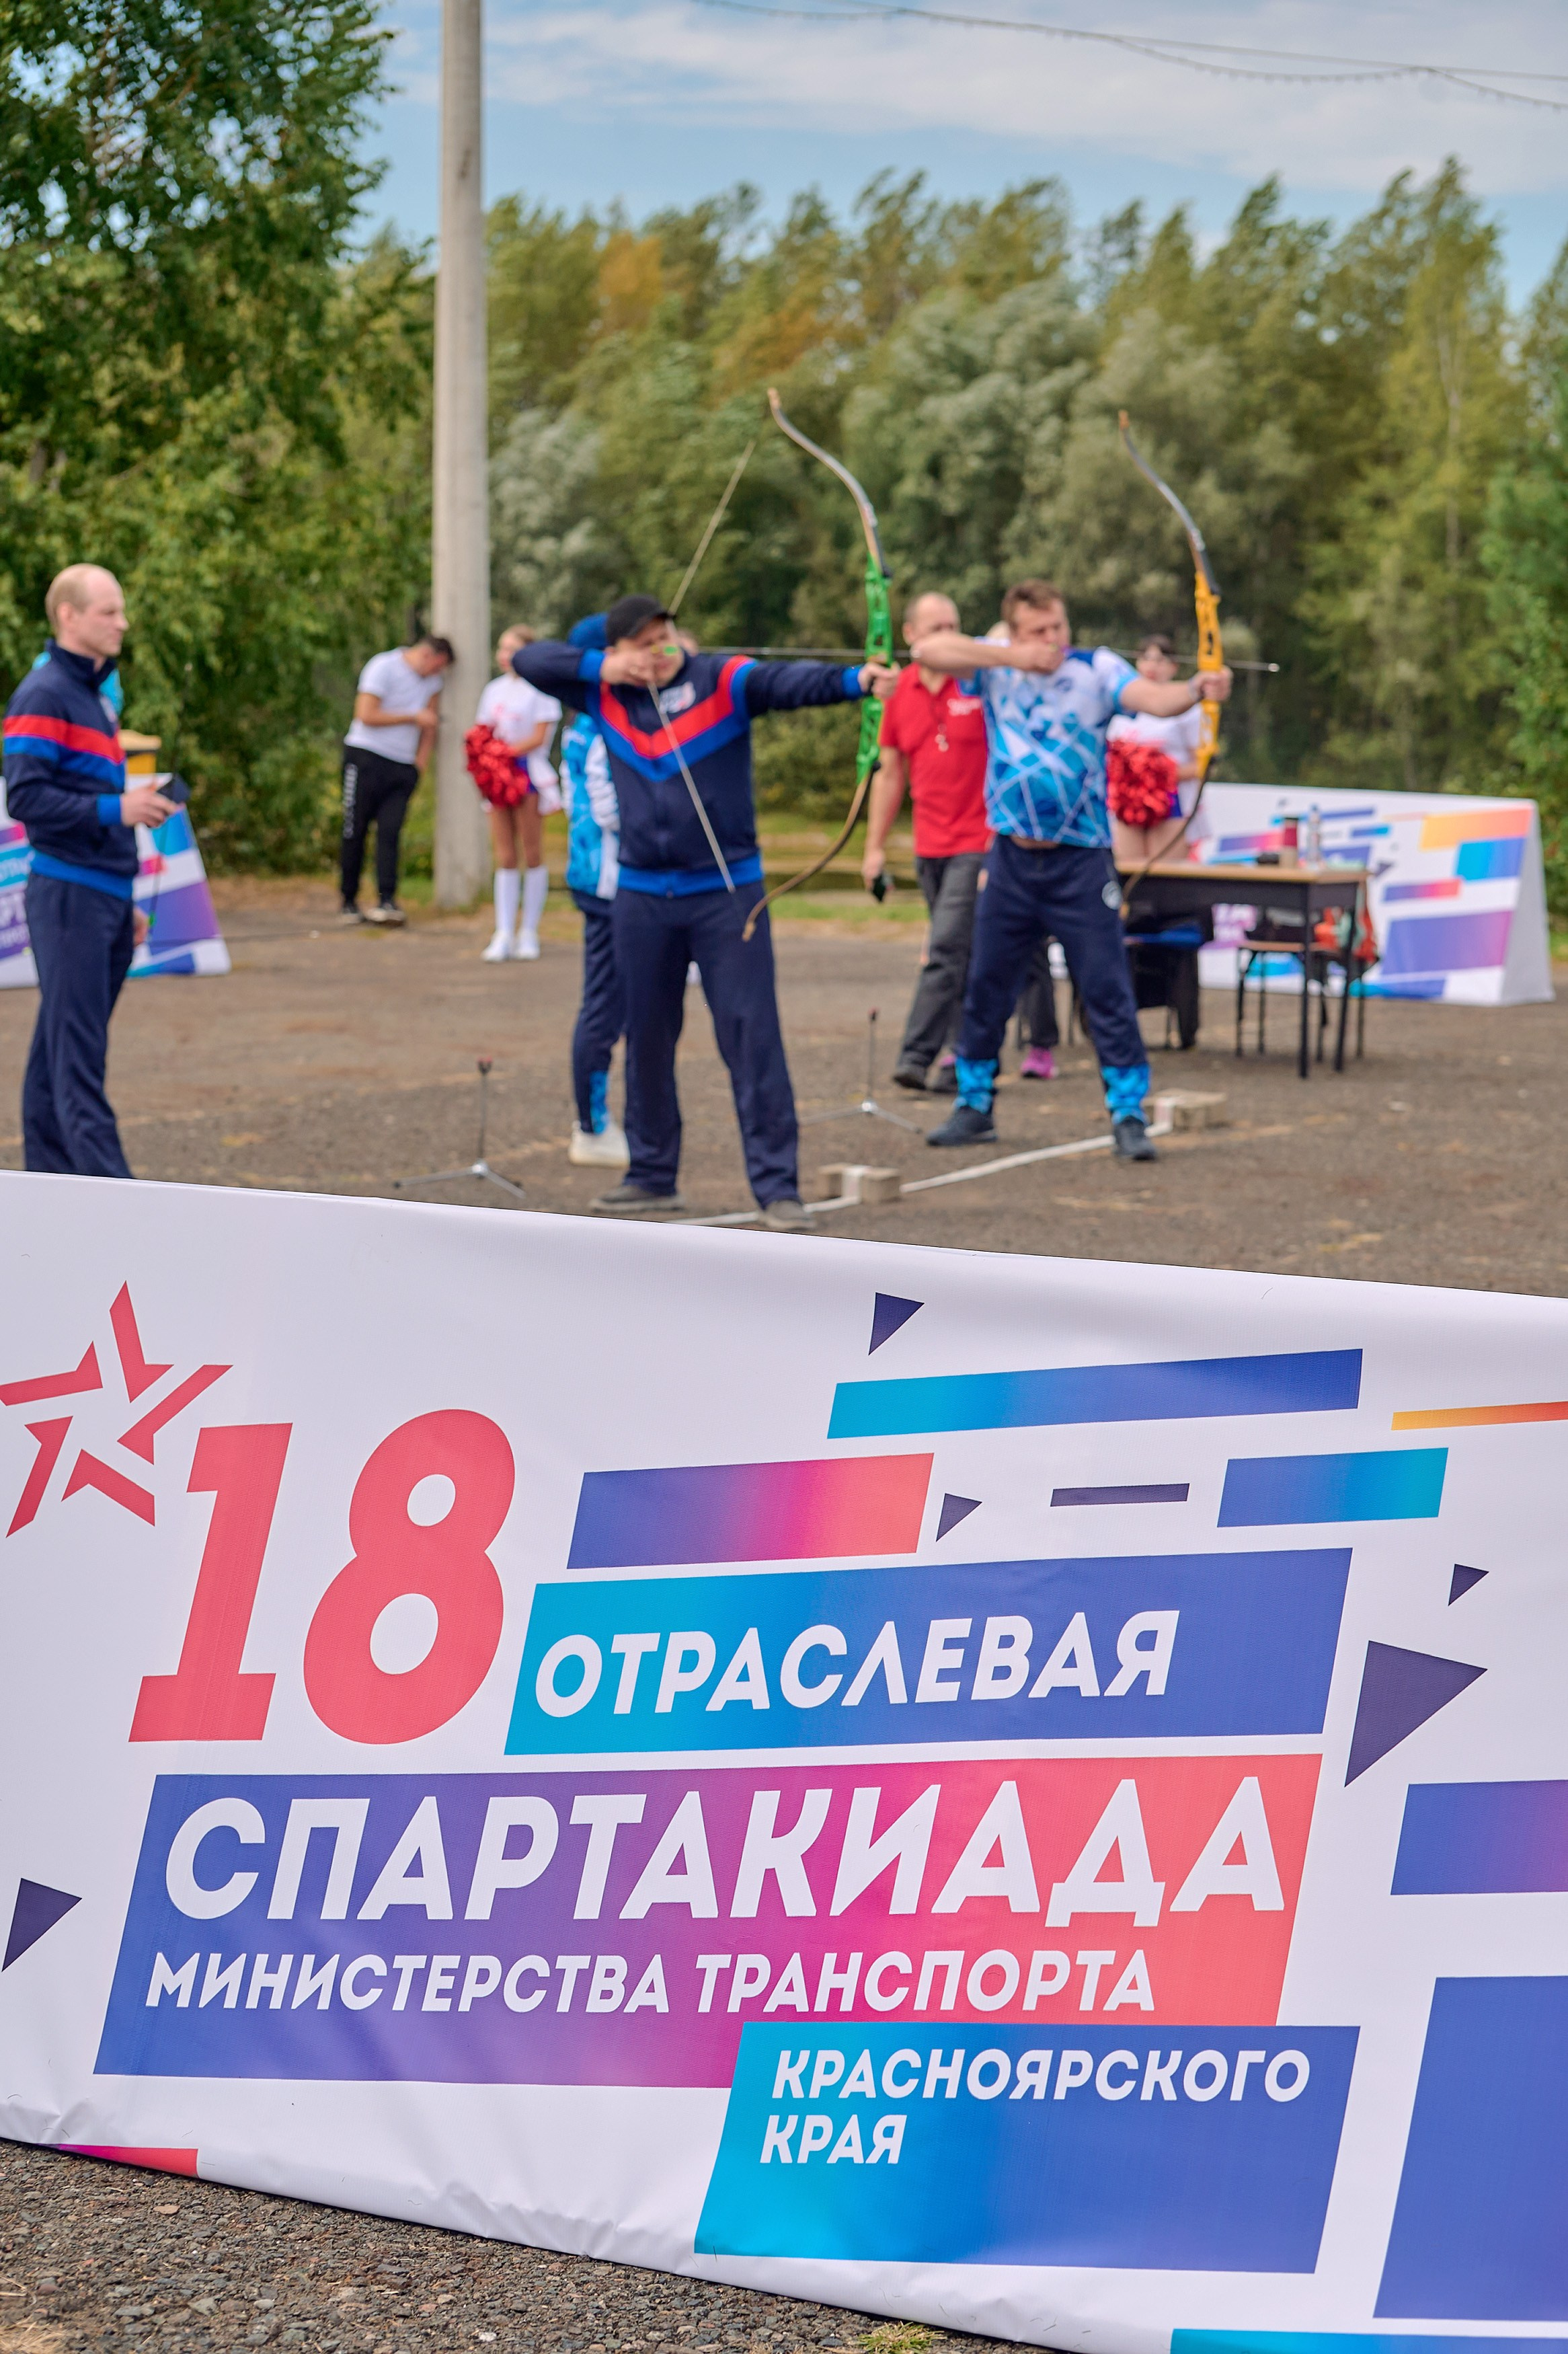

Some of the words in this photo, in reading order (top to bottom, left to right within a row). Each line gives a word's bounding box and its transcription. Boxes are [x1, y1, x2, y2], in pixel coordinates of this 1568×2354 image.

[128, 1409, 515, 1744] 18
[535, 1610, 1180, 1718] ОТРАСЛЕВАЯ
[165, 1776, 1286, 1928] СПАРТАКИАДА
[145, 1952, 670, 2013] МИНИСТЕРСТВА
[695, 1949, 1154, 2013] ТРАНСПОРТА
[771, 2048, 1310, 2102] КРАСНОЯРСКОГО
[760, 2114, 908, 2164] КРАЯ
